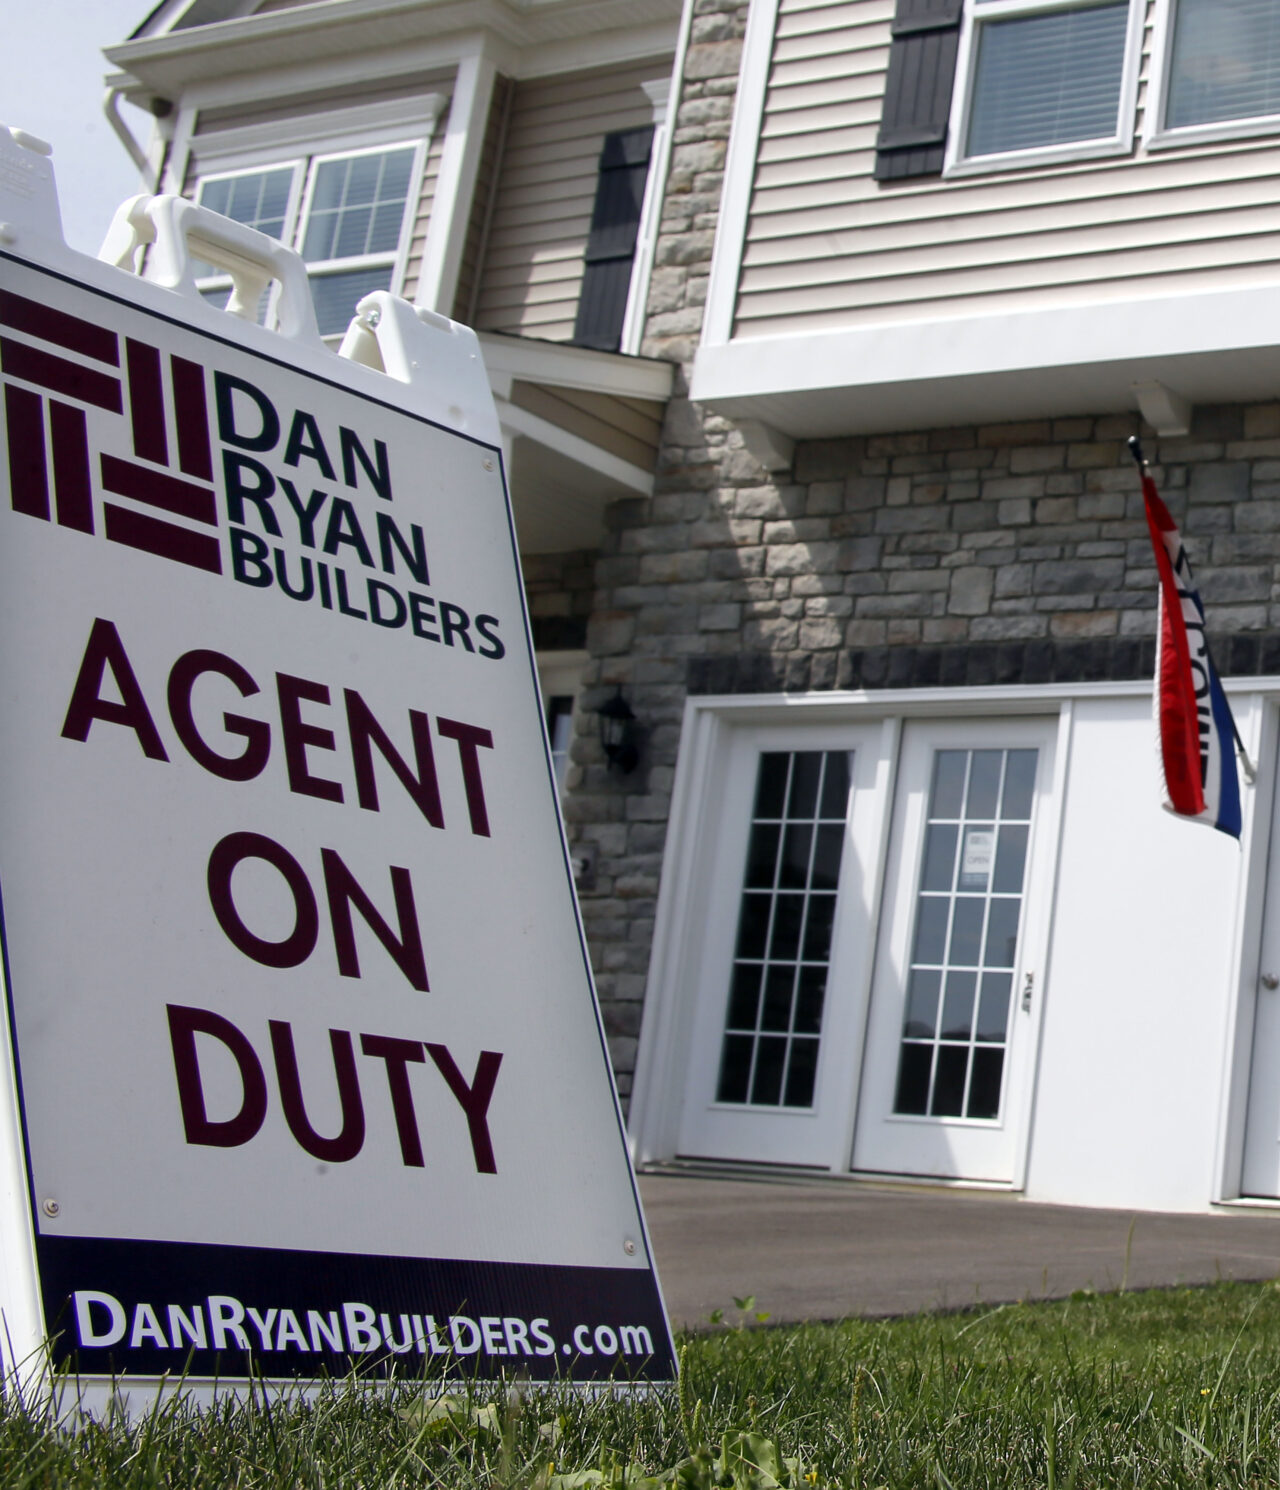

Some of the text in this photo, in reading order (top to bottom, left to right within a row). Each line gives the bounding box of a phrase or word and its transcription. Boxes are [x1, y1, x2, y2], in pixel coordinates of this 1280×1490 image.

[214, 369, 393, 501] DAN
[222, 448, 431, 586] RYAN
[228, 526, 506, 660] BUILDERS
[60, 617, 495, 838] AGENT
[206, 831, 431, 993] ON
[165, 1003, 504, 1175] DUTY
